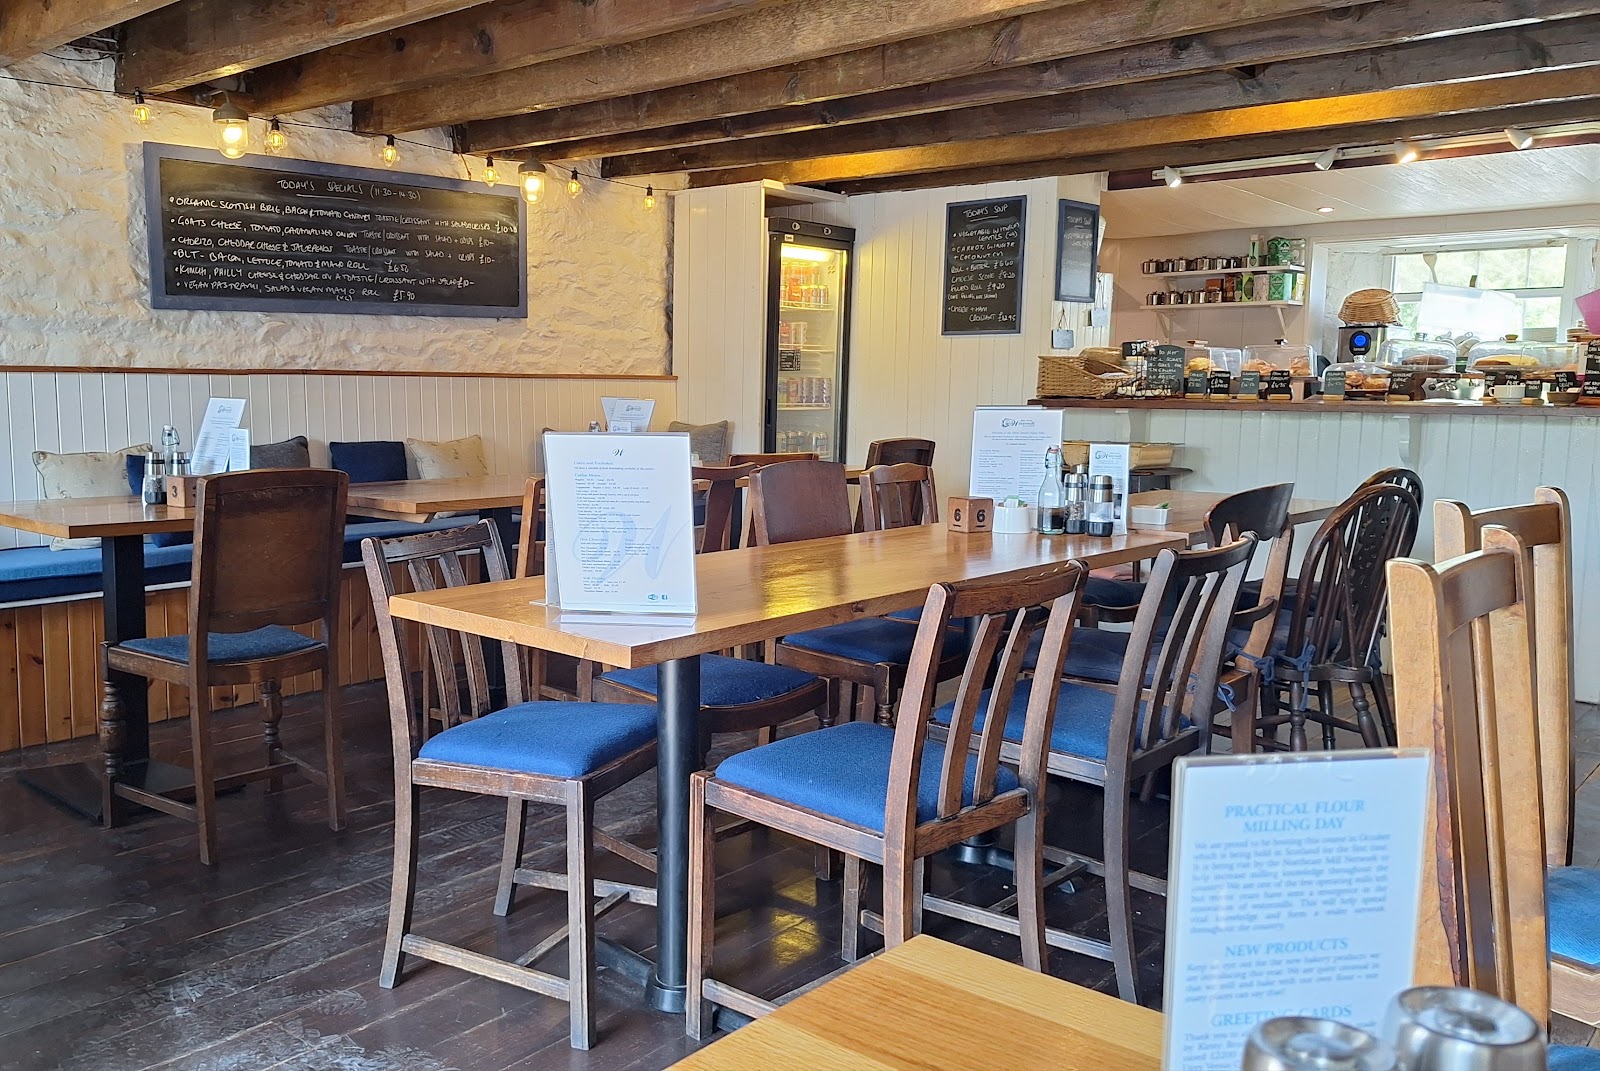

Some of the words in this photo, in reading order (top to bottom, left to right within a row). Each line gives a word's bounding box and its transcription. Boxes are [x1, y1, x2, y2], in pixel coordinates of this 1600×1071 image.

[277, 179, 315, 191] TODAY'S
[326, 181, 364, 195] SPECIALS
[176, 197, 218, 208] ORGANIC
[219, 200, 256, 211] SCOTTISH
[993, 203, 1008, 214] SOUP
[177, 215, 206, 227] GOATS
[335, 230, 358, 239] ONION
[958, 228, 991, 237] VEGETABLE
[978, 233, 1003, 242] LENTILS
[217, 238, 256, 250] CHEDDAR
[256, 241, 281, 252] CHEESE
[177, 248, 200, 260] BLT
[346, 260, 370, 271] ROLL
[960, 252, 991, 261] COCONUT
[213, 266, 242, 278] PHILLY
[285, 272, 320, 281] CHEDDAR
[951, 274, 975, 284] CHEESE
[978, 272, 995, 281] SCONE
[184, 279, 209, 290] VEGAN
[264, 284, 290, 293] SALAD
[296, 285, 324, 294] VEGAN
[171, 485, 178, 498] 3
[953, 508, 962, 522] 6
[976, 508, 986, 523] 6
[1224, 803, 1309, 818] PRACTICAL
[1315, 799, 1366, 813] FLOUR
[1243, 818, 1311, 832] MILLING
[1314, 816, 1345, 830] DAY
[1224, 943, 1262, 957] NEW
[1264, 937, 1350, 955] PRODUCTS
